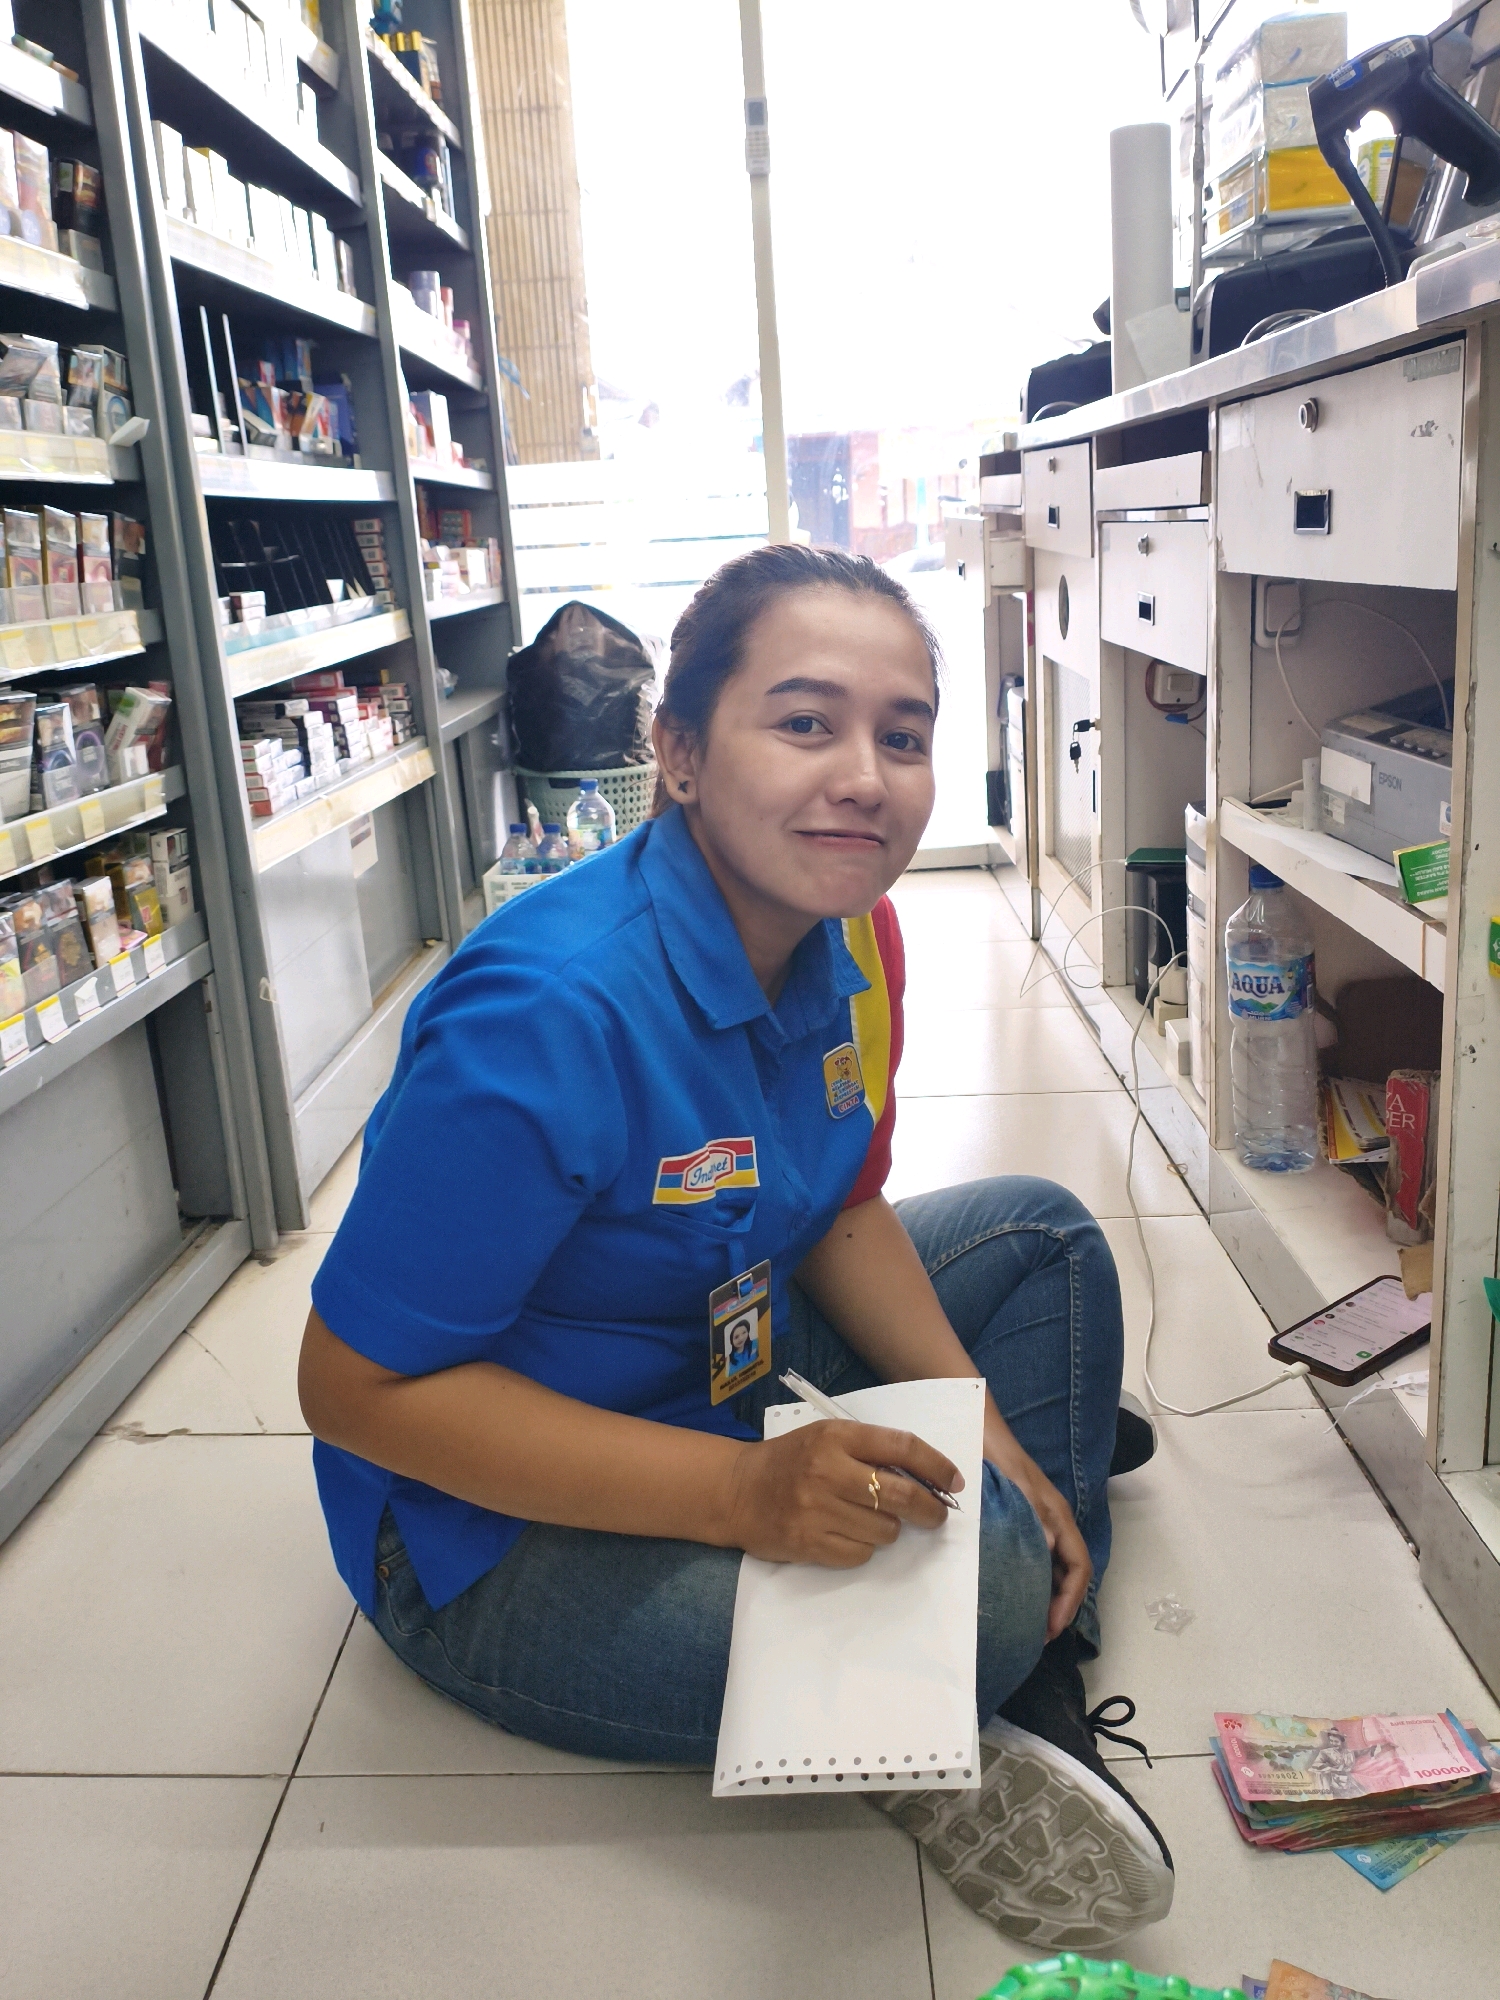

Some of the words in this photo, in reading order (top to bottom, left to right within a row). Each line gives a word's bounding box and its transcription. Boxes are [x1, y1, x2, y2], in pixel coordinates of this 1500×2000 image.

[1378, 771, 1402, 792] EPSON
[1231, 971, 1285, 998] AQUA
[838, 1096, 859, 1113] CINTA
[1413, 1765, 1471, 1779] 100000
